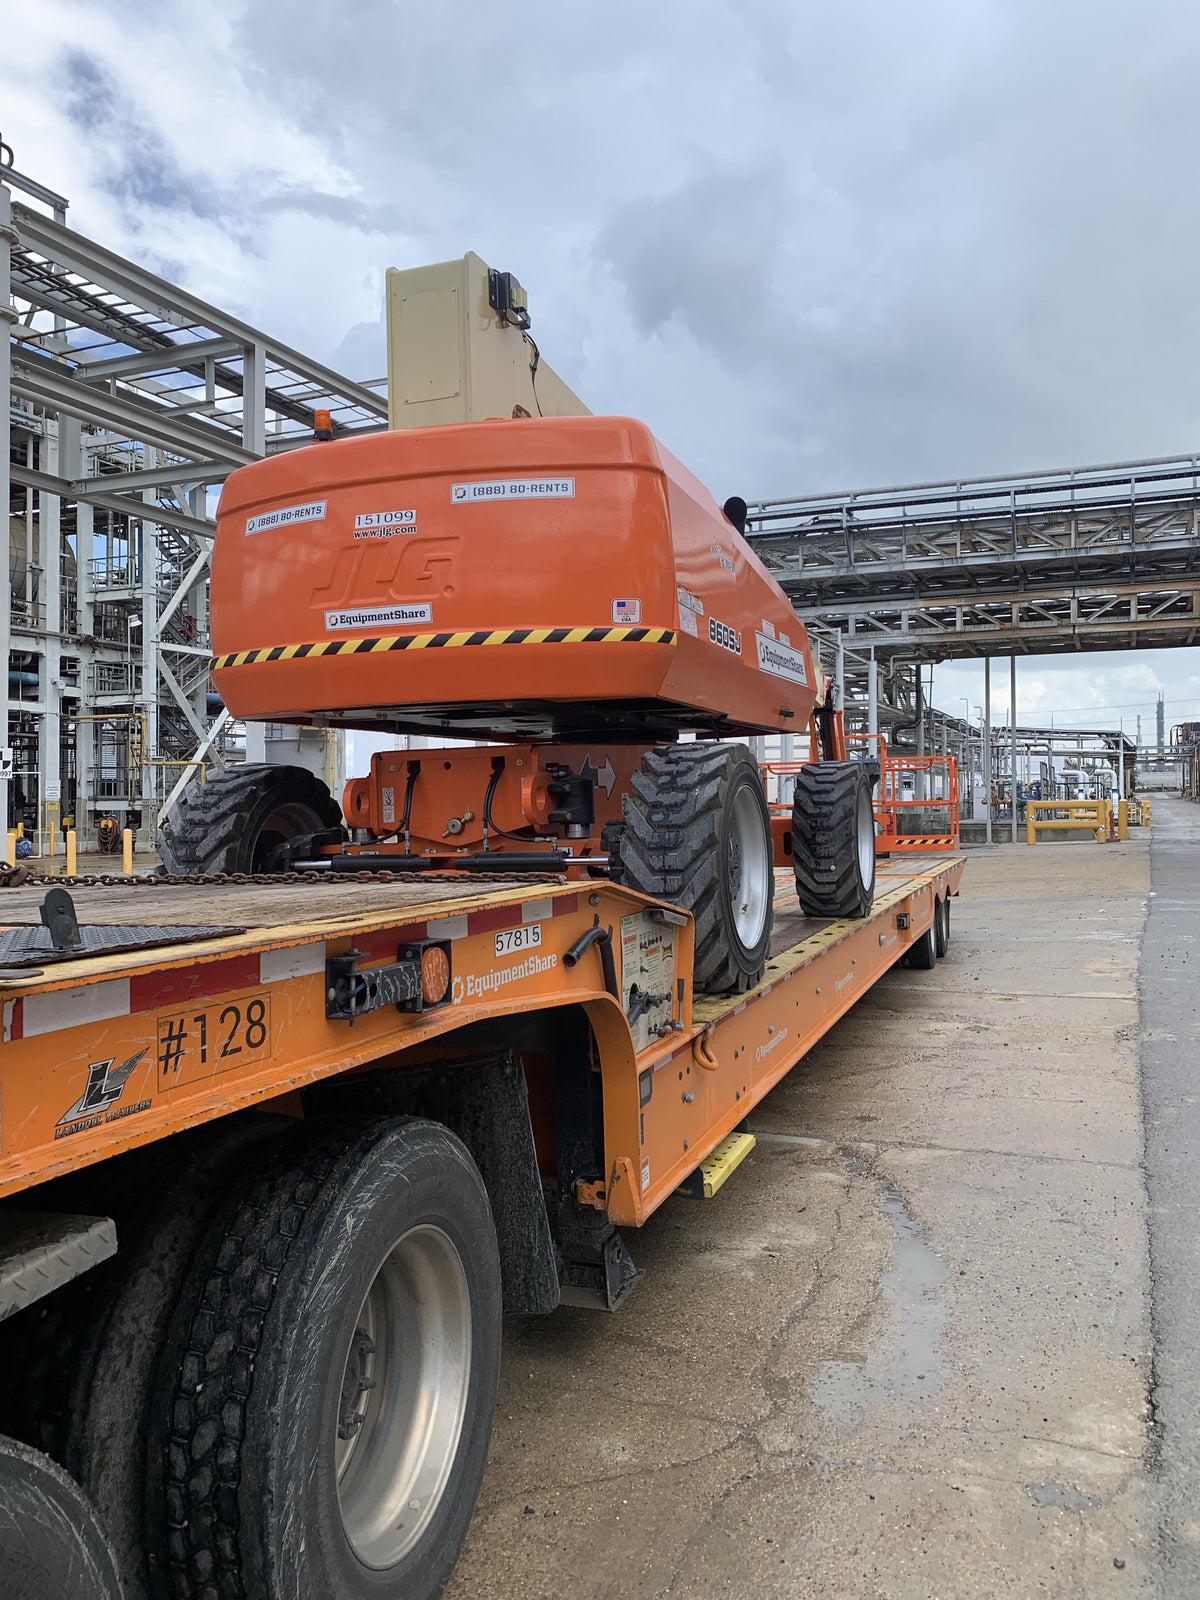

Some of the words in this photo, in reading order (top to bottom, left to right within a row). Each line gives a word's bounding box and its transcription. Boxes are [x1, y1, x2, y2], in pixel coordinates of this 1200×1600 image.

[472, 484, 506, 497] (888)
[509, 482, 569, 494] 80-RENTS
[257, 514, 279, 528] (888)
[280, 505, 322, 522] 80-RENTS
[356, 510, 414, 526] 151099
[353, 525, 417, 539] www.jlg.com
[309, 535, 460, 609] JLG
[339, 609, 427, 626] EquipmentShare
[495, 925, 541, 952] 57815
[466, 953, 557, 998] EquipmentShare
[159, 999, 266, 1076] #128
[105, 1099, 152, 1124] TRAILERS
